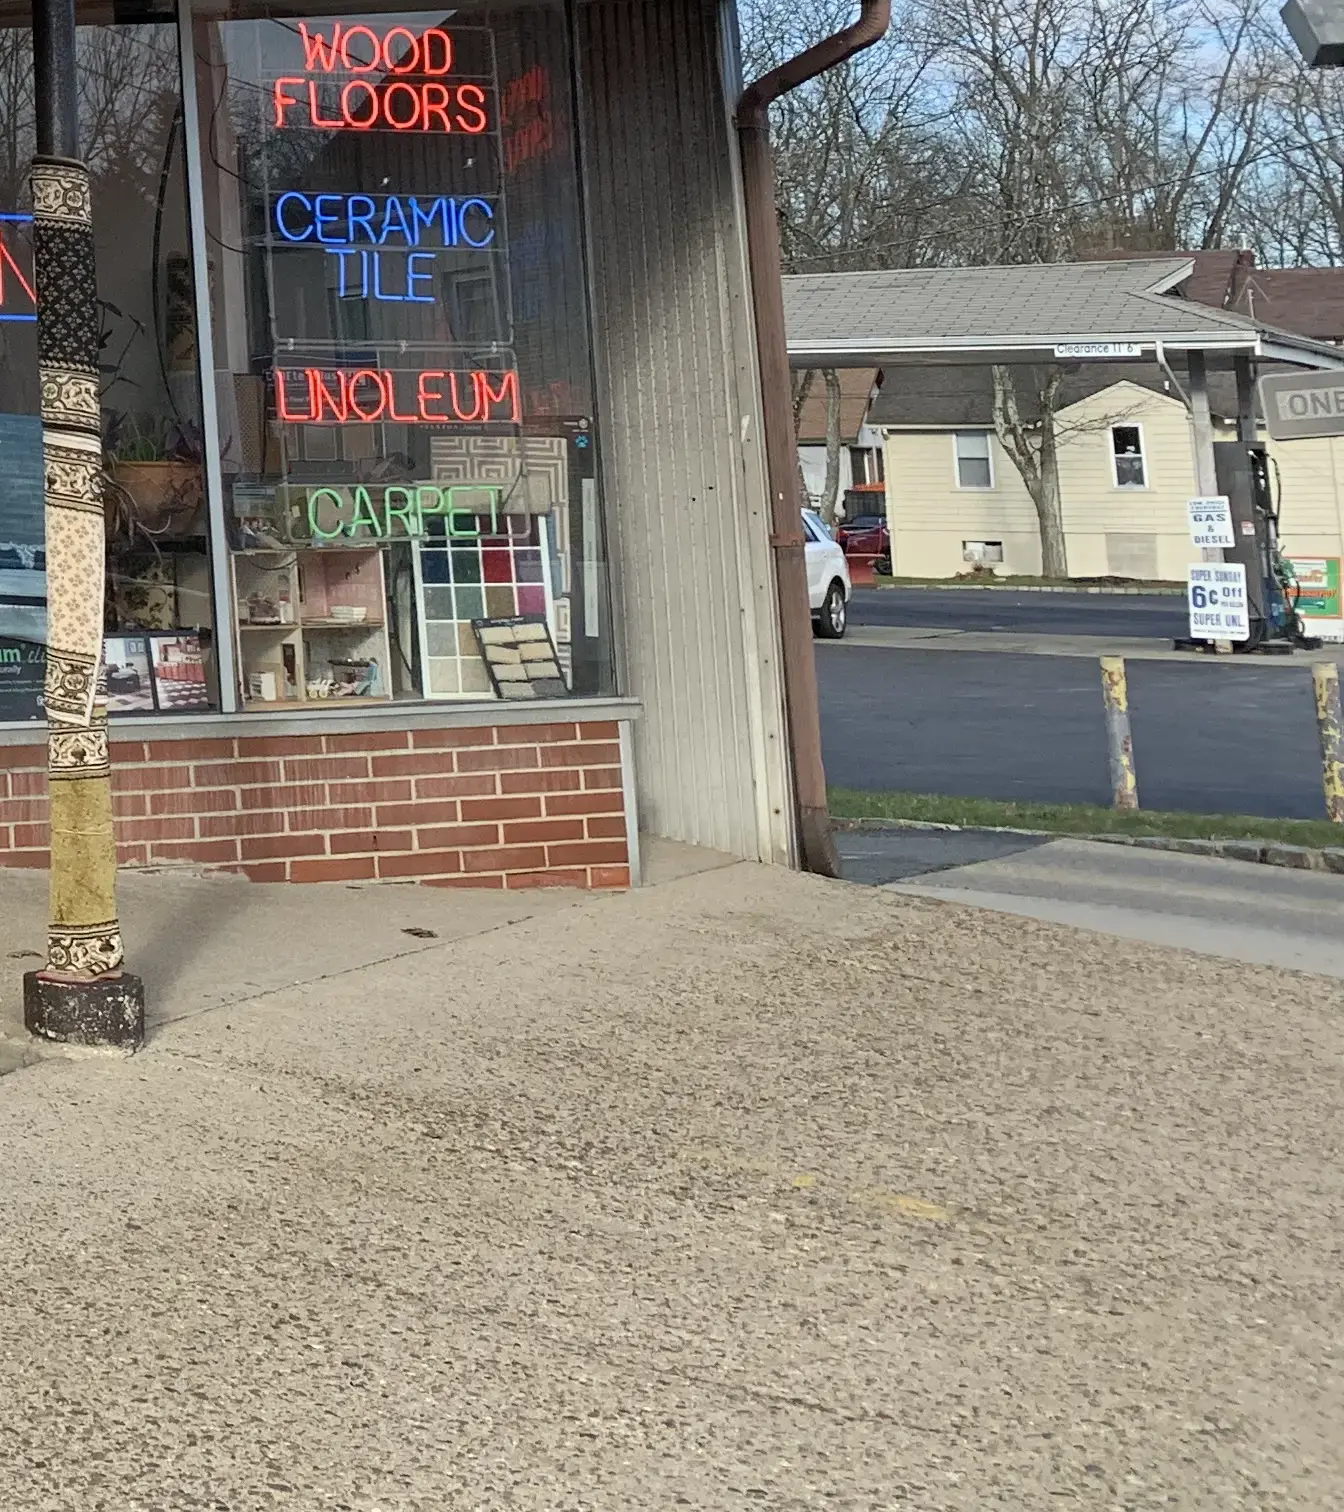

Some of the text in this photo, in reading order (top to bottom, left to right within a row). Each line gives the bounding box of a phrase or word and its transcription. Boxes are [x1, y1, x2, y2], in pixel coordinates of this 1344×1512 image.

[297, 22, 453, 76] WOOD
[274, 76, 488, 133] FLOORS
[274, 191, 496, 248] CERAMIC
[324, 248, 437, 303] TILE
[1057, 344, 1109, 354] Clearance
[275, 368, 521, 423] LINOLEUM
[1288, 389, 1344, 418] ONE
[308, 486, 503, 538] CARPET
[1193, 513, 1226, 522] GAS
[1194, 535, 1231, 544] DIESEL
[1207, 525, 1215, 533] &
[1191, 569, 1241, 583] SUPER SUNDAY
[1222, 587, 1242, 598] Off
[1193, 612, 1221, 626] SUPER
